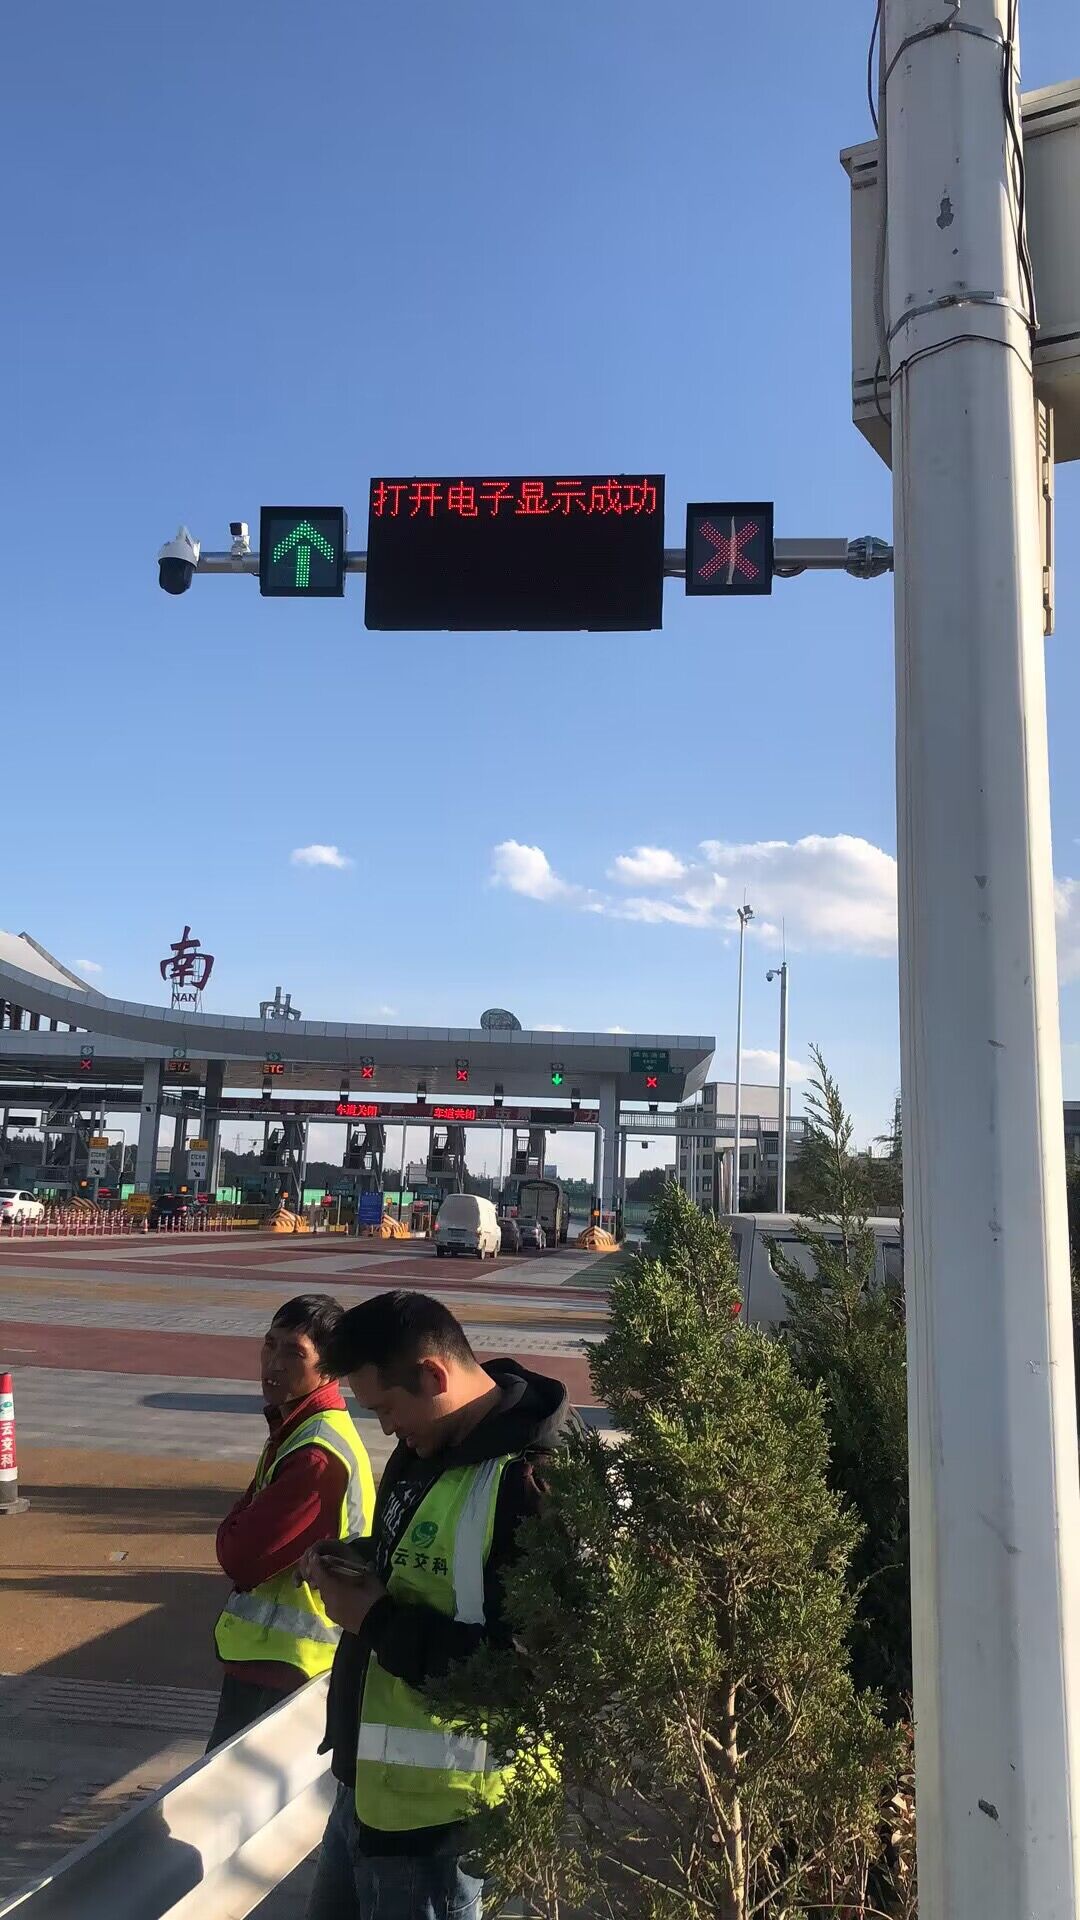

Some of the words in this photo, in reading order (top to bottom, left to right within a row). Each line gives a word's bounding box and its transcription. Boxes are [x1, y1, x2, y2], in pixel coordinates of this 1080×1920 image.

[373, 478, 657, 517] 打开电子显示成功
[159, 925, 214, 991] 南
[172, 993, 197, 1001] NAN
[168, 1061, 191, 1072] ETC
[263, 1064, 285, 1075] ETC
[433, 1107, 476, 1120] 车道关闭
[1, 1422, 14, 1467] 云交科
[393, 1547, 449, 1576] 云交科
